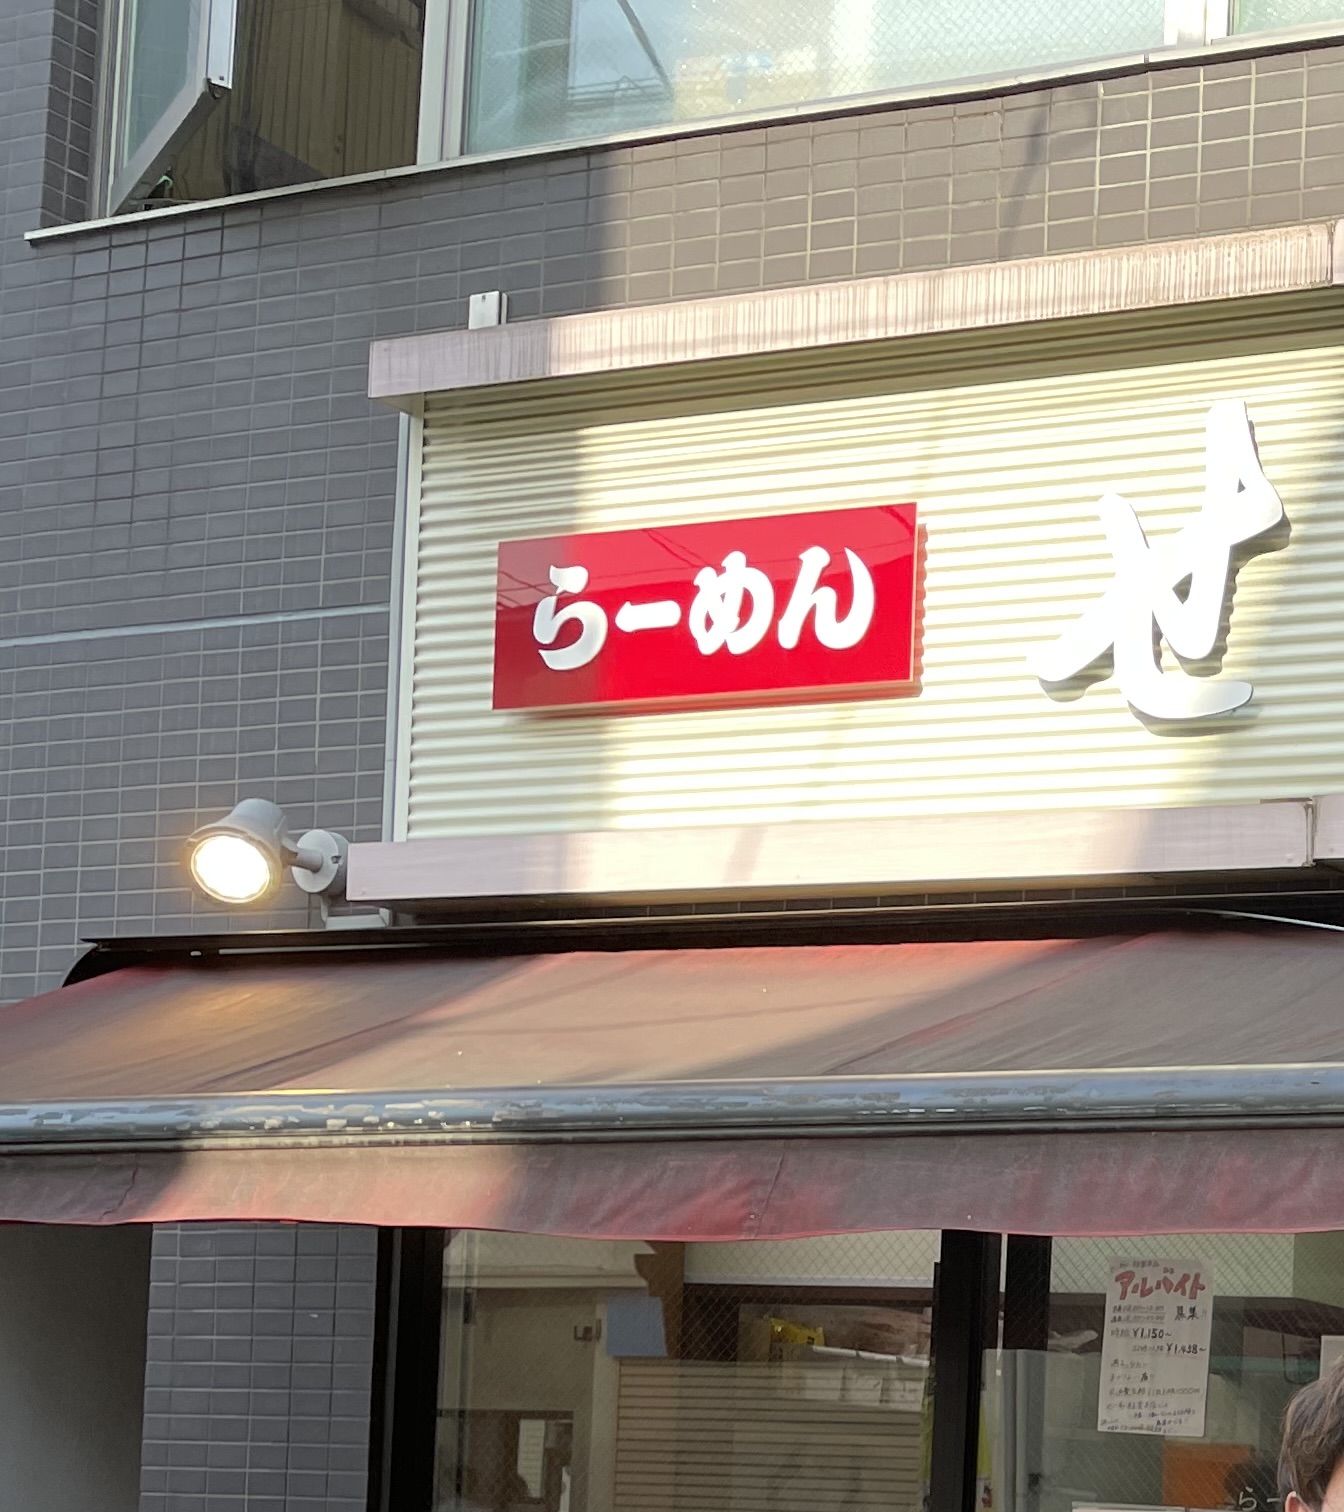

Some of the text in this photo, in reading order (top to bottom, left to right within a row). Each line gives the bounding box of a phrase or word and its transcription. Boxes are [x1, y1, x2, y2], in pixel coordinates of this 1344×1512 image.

[532, 544, 875, 672] らーめん
[1115, 1266, 1205, 1300] アルバイト
